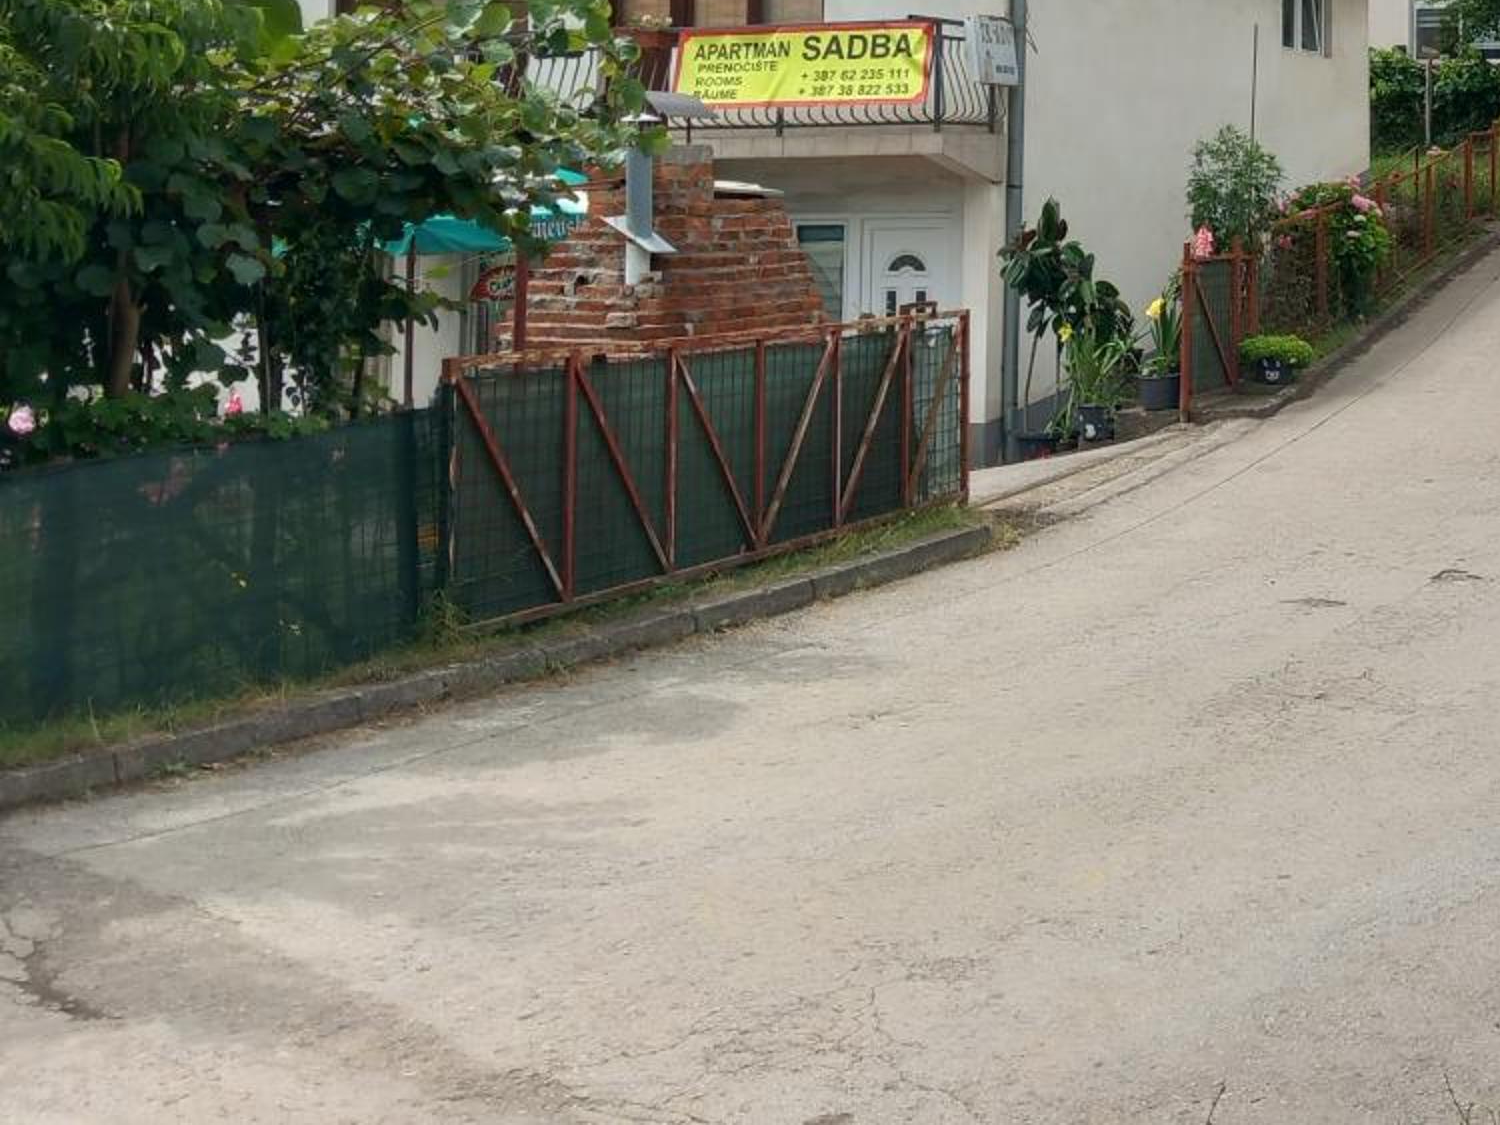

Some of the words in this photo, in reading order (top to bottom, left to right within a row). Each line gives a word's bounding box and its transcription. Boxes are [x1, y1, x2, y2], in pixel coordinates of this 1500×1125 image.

[694, 40, 791, 61] APARTMAN
[802, 33, 913, 61] SADBA
[695, 76, 743, 88] ROOMS
[813, 69, 836, 82] 387
[840, 69, 857, 82] 62
[860, 68, 885, 80] 235
[888, 67, 910, 79] 111
